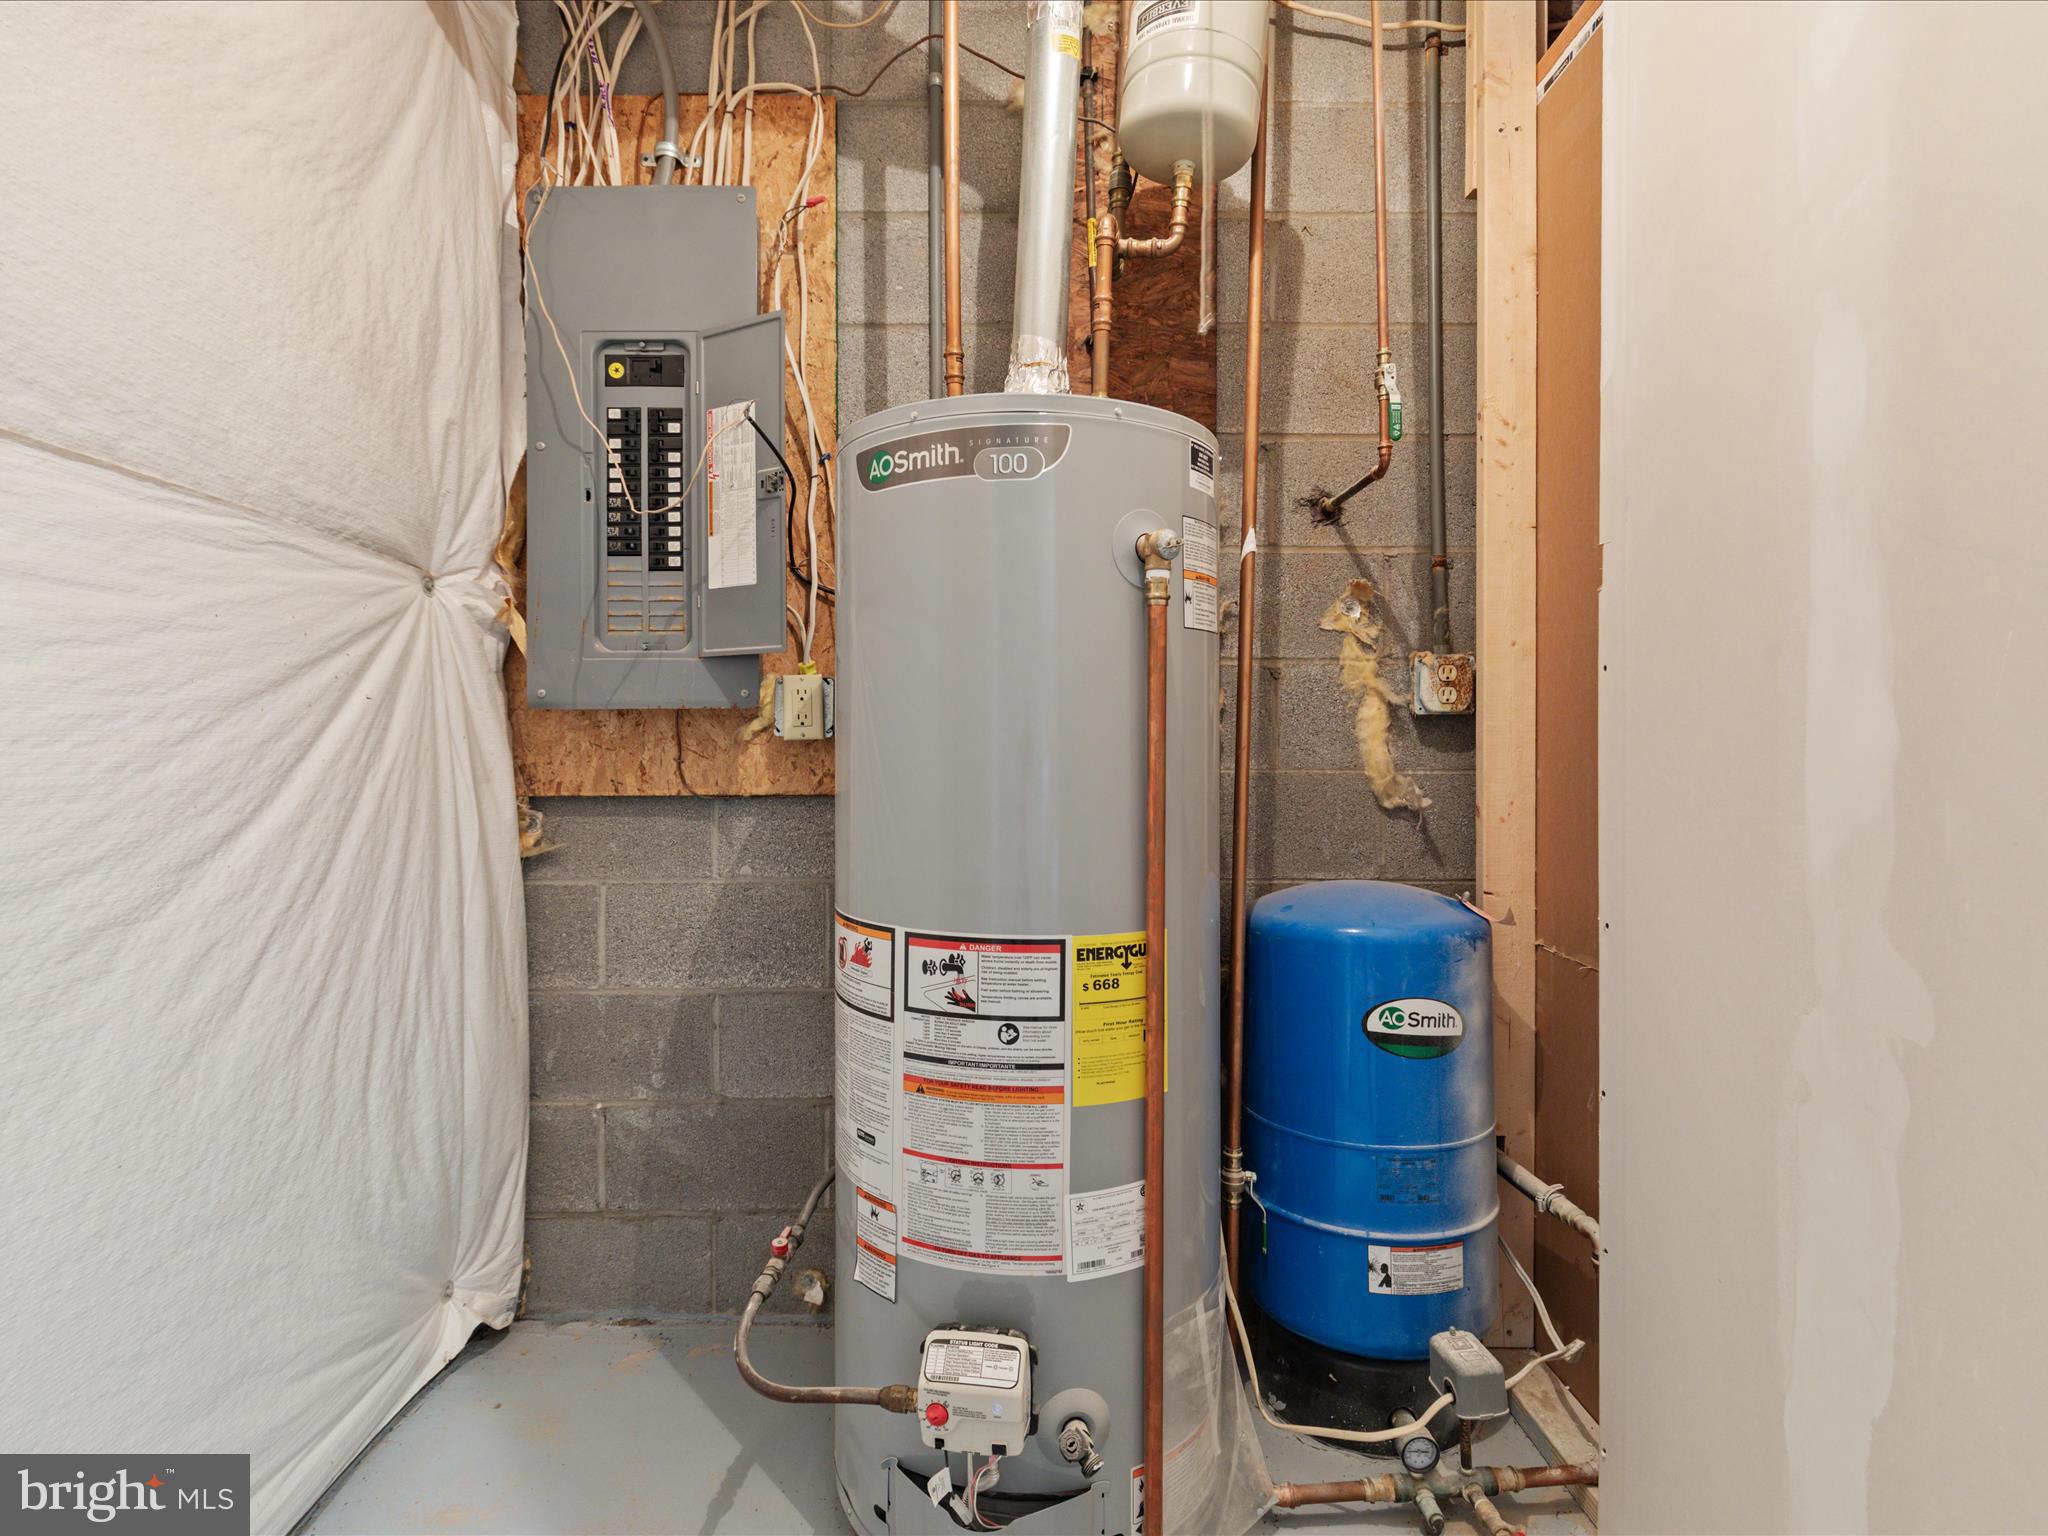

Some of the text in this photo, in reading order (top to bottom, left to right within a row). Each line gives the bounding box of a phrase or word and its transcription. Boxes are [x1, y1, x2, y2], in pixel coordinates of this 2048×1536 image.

[970, 436, 1048, 446] SIGNATURE
[990, 453, 1027, 474] 100
[969, 944, 1002, 952] DANGER
[1076, 943, 1146, 962] ENERGYGU
[1093, 978, 1119, 991] 668
[950, 1081, 969, 1089] SAFETY
